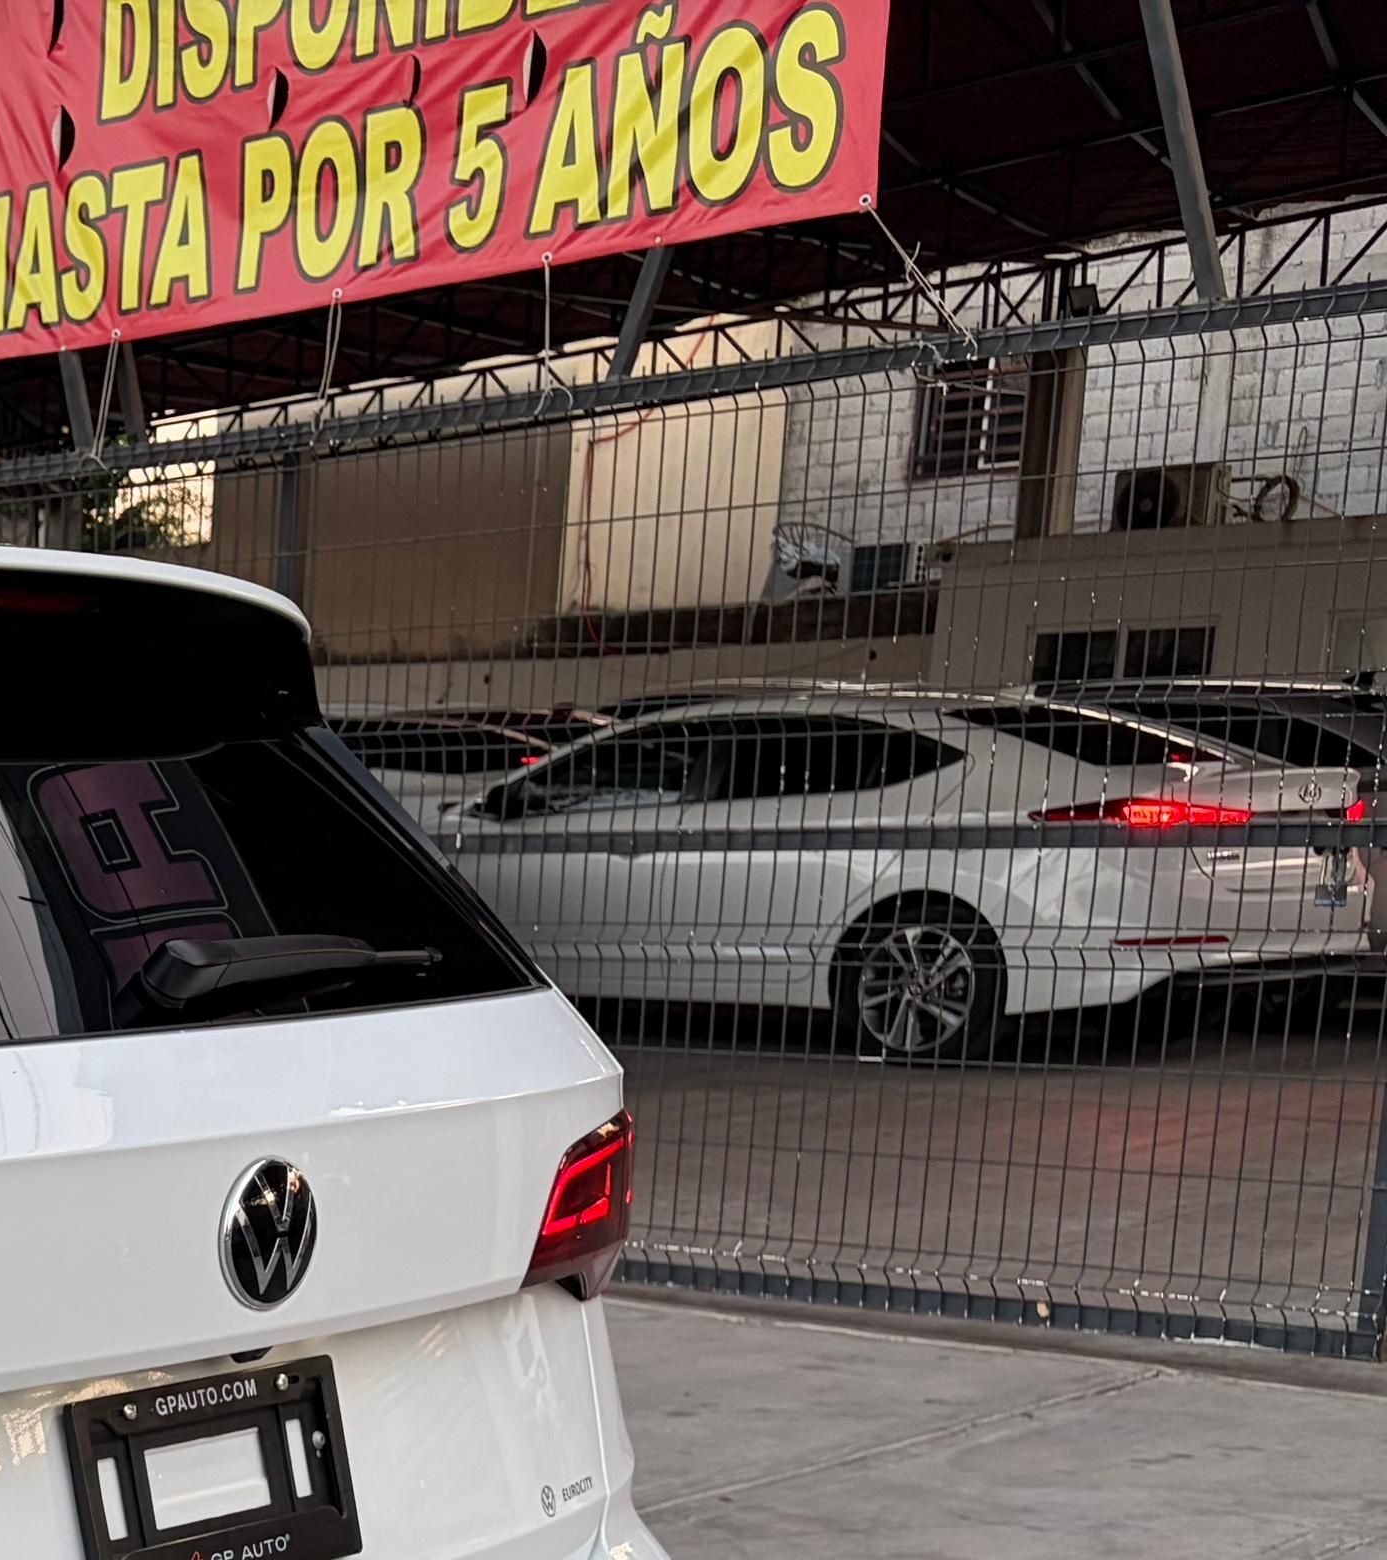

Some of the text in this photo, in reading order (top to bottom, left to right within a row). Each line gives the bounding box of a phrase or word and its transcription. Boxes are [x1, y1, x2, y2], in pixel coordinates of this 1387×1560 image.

[237, 103, 426, 295] POR
[446, 79, 513, 253] 5
[525, 4, 844, 239] AÑOS
[155, 1378, 258, 1416] GPAUTO.COM
